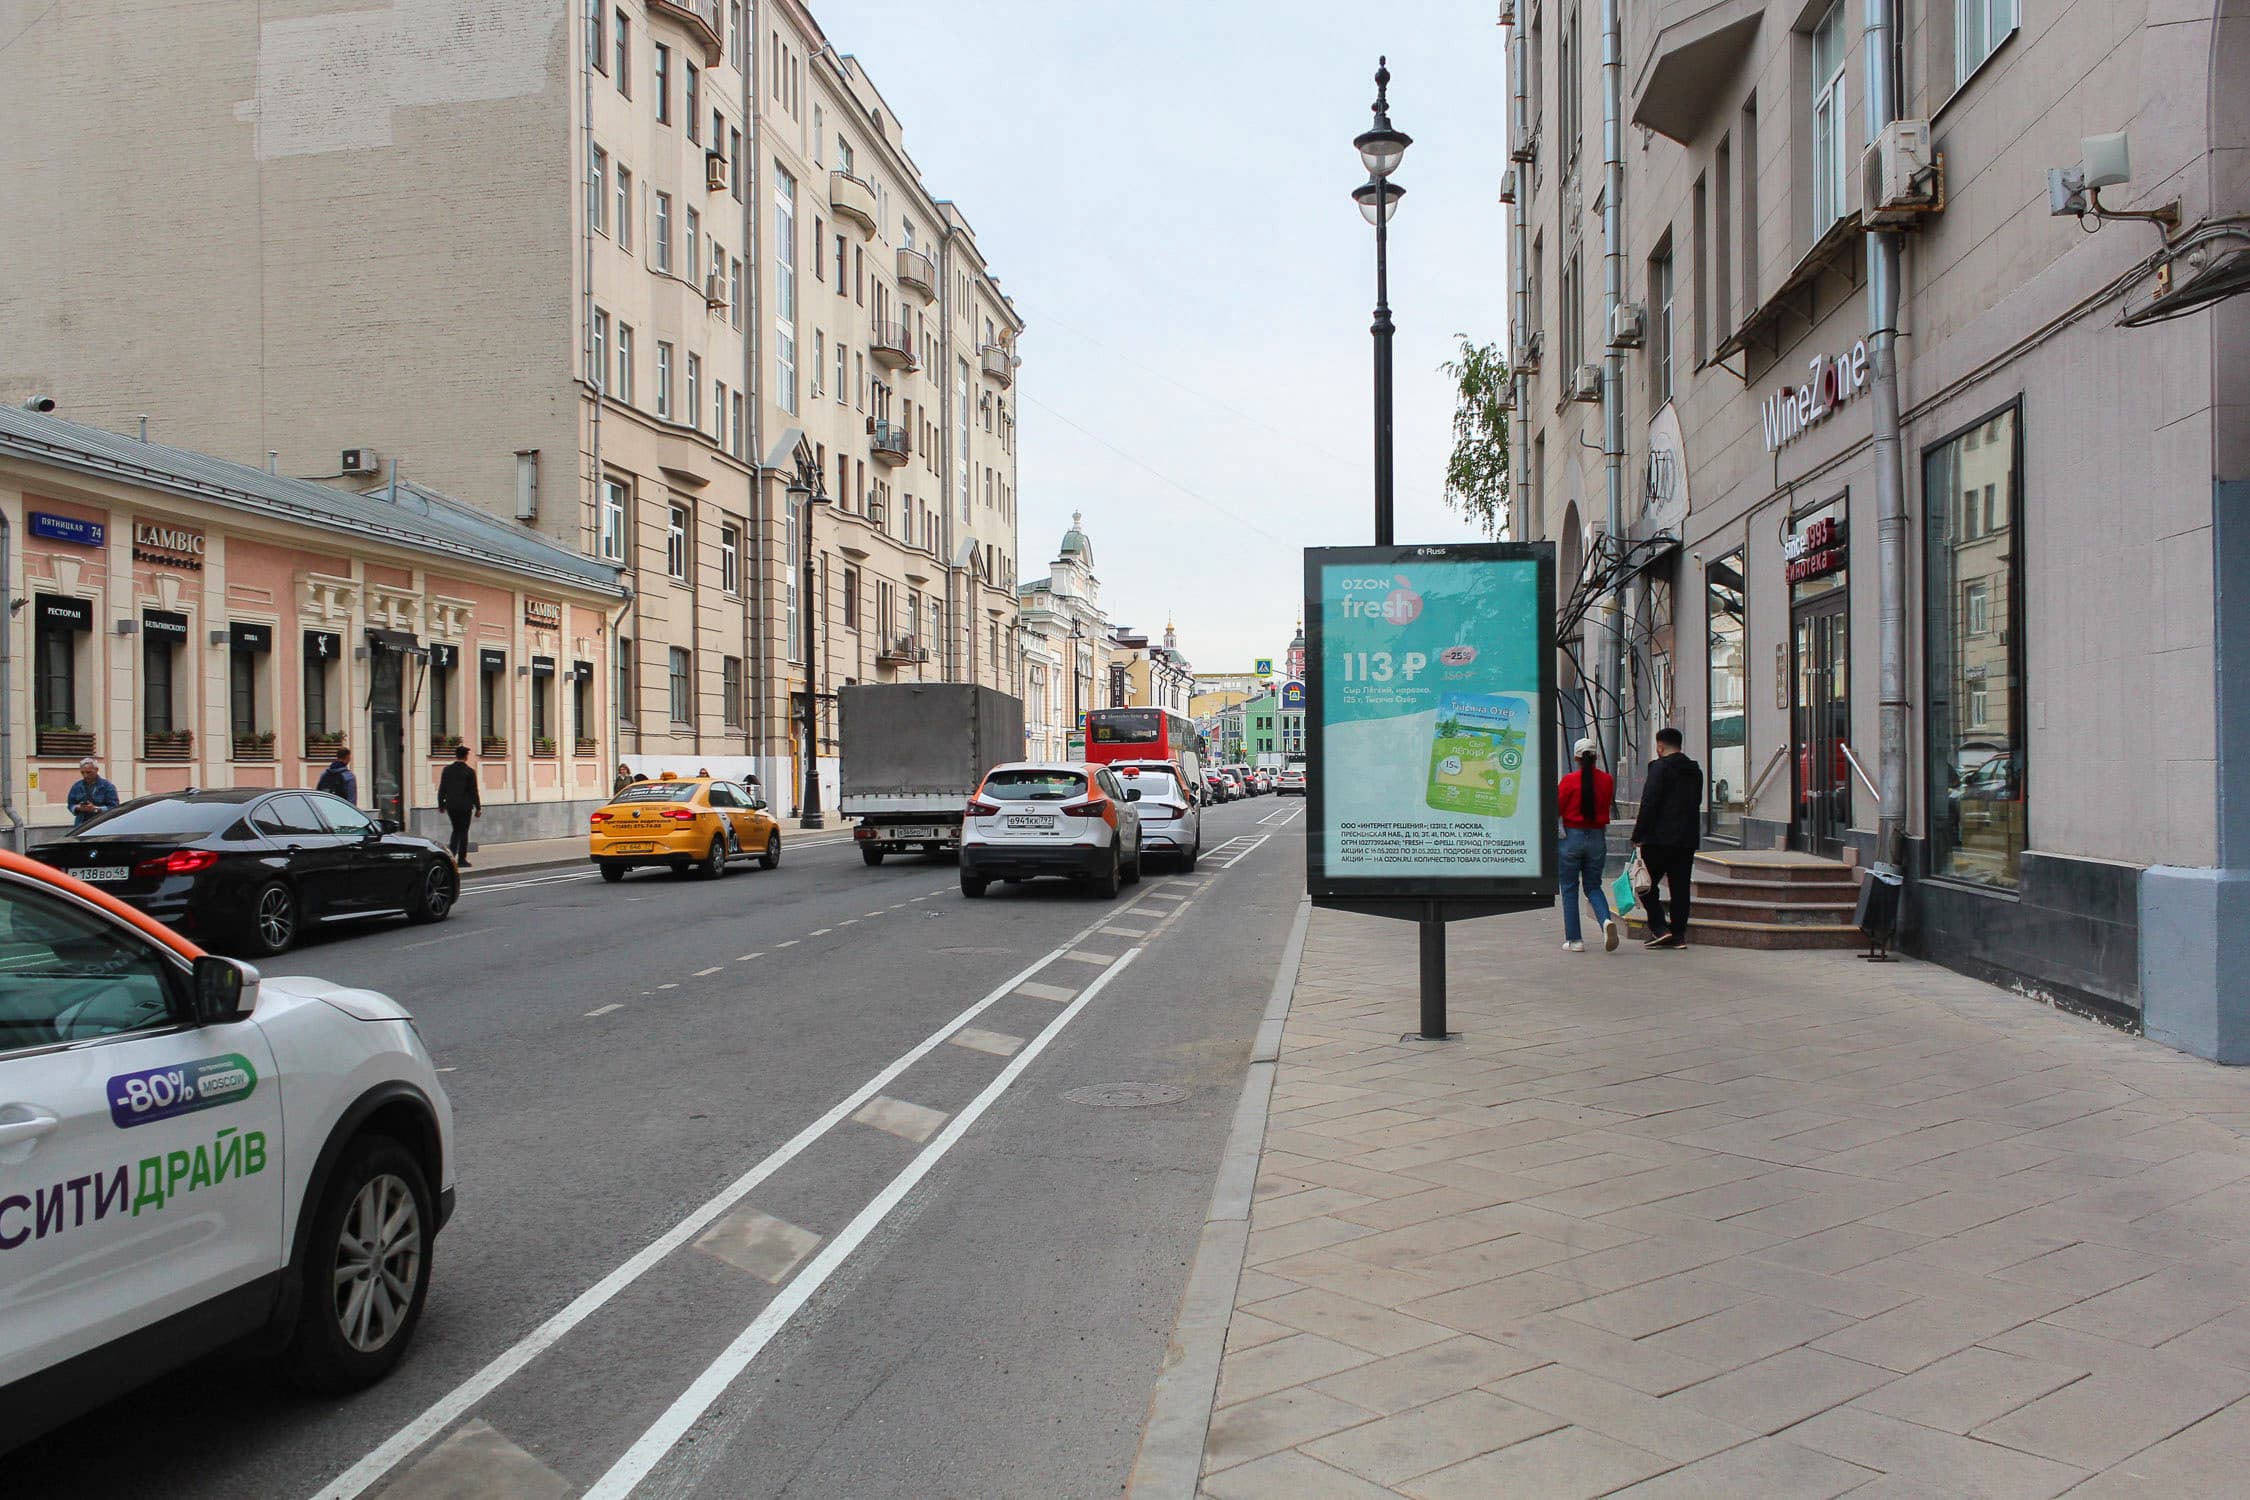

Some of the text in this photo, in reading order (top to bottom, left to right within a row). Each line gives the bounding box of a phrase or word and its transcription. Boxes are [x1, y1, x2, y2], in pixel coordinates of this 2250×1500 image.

[1762, 340, 1866, 452] WineZone
[41, 517, 102, 538] ПЯТНИЦКАЯ 74
[136, 523, 205, 554] LAMBIC
[1784, 518, 1828, 560] since 1993
[1342, 579, 1390, 590] OZON
[48, 607, 81, 618] РЕСТОРАН
[528, 600, 560, 619] LAMBIC
[1341, 592, 1414, 618] fresh
[1343, 652, 1427, 681] 113 ₽
[1343, 687, 1360, 695] Сыр
[117, 1070, 194, 1112] -80%
[203, 1074, 245, 1092] MOSCOW
[0, 1127, 267, 1250] СИТИДРАЙВ
